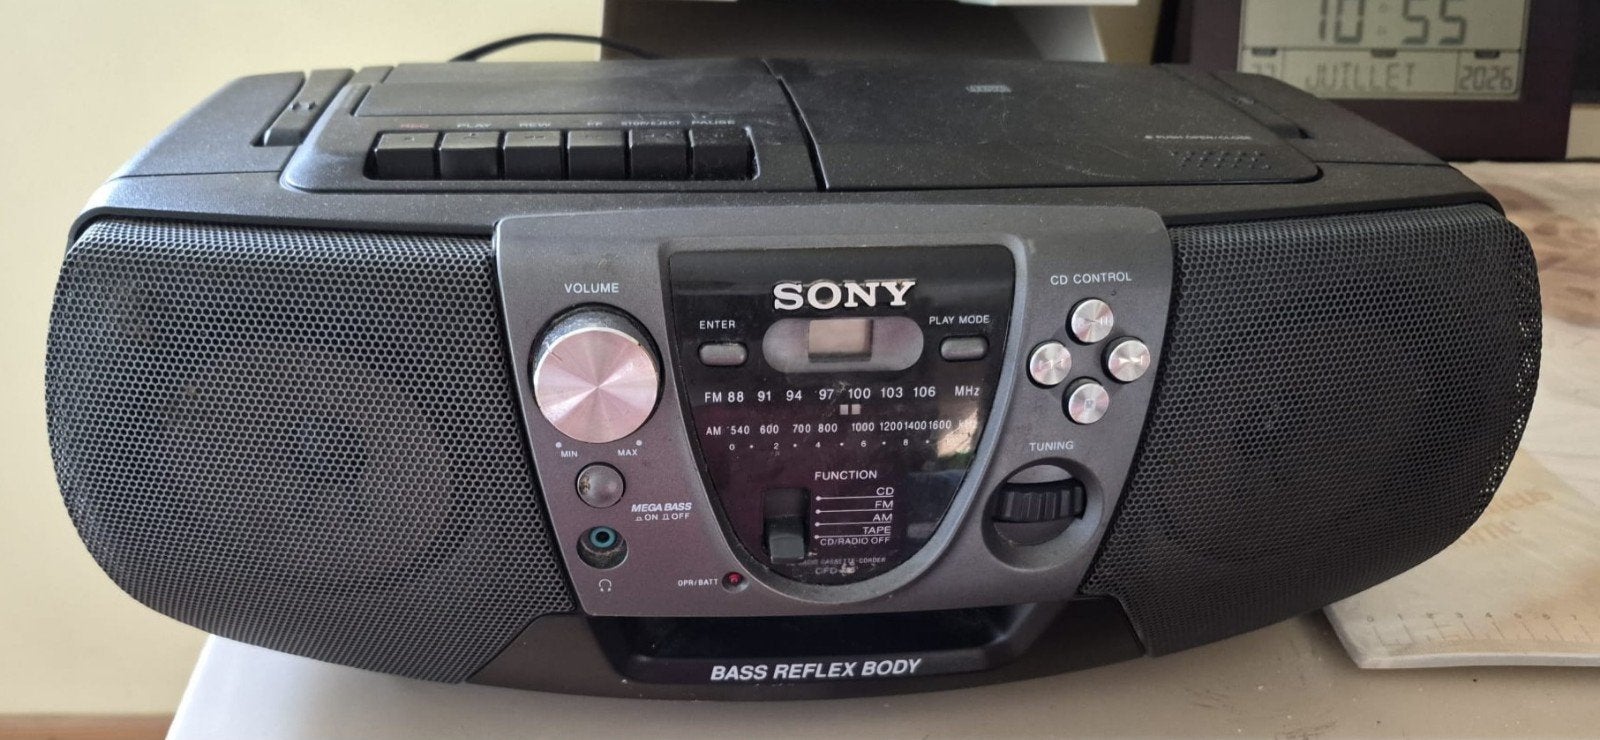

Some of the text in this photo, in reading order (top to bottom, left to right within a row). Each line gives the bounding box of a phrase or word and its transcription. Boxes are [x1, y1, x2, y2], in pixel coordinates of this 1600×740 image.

[1304, 62, 1416, 91] JUILLET
[1459, 64, 1513, 91] 2026
[1050, 271, 1132, 286] CD CONTROL
[564, 282, 620, 294] VOLUME
[773, 279, 916, 310] SONY
[699, 319, 736, 330] ENTER
[929, 314, 991, 326] PLAY MODE
[704, 385, 980, 403] FM 88 91 94 97 100 103 106 MHz
[705, 426, 722, 436] AM
[730, 425, 750, 435] 540
[759, 424, 780, 435] 600
[792, 423, 811, 434] 700
[818, 423, 838, 434] 800
[851, 421, 875, 432] 1000
[880, 421, 903, 431] 1200
[905, 420, 927, 430] 1400
[929, 420, 952, 430] 1600
[773, 442, 780, 450] 2
[861, 440, 867, 448] 6
[1029, 441, 1074, 451] TUNING
[560, 450, 578, 458] MIN
[617, 449, 638, 457] MAX
[814, 470, 878, 481] FUNCTION
[876, 487, 895, 496] CD
[631, 502, 692, 512] MEGA BASS
[875, 500, 894, 509] FM
[644, 512, 690, 522] ON OFF
[872, 513, 893, 522] AM
[863, 526, 891, 534] TAPE
[819, 537, 891, 546] CD/RADIO OFF
[677, 578, 718, 587] OPR/BATT
[711, 658, 922, 681] BASS REFLEX BODY
